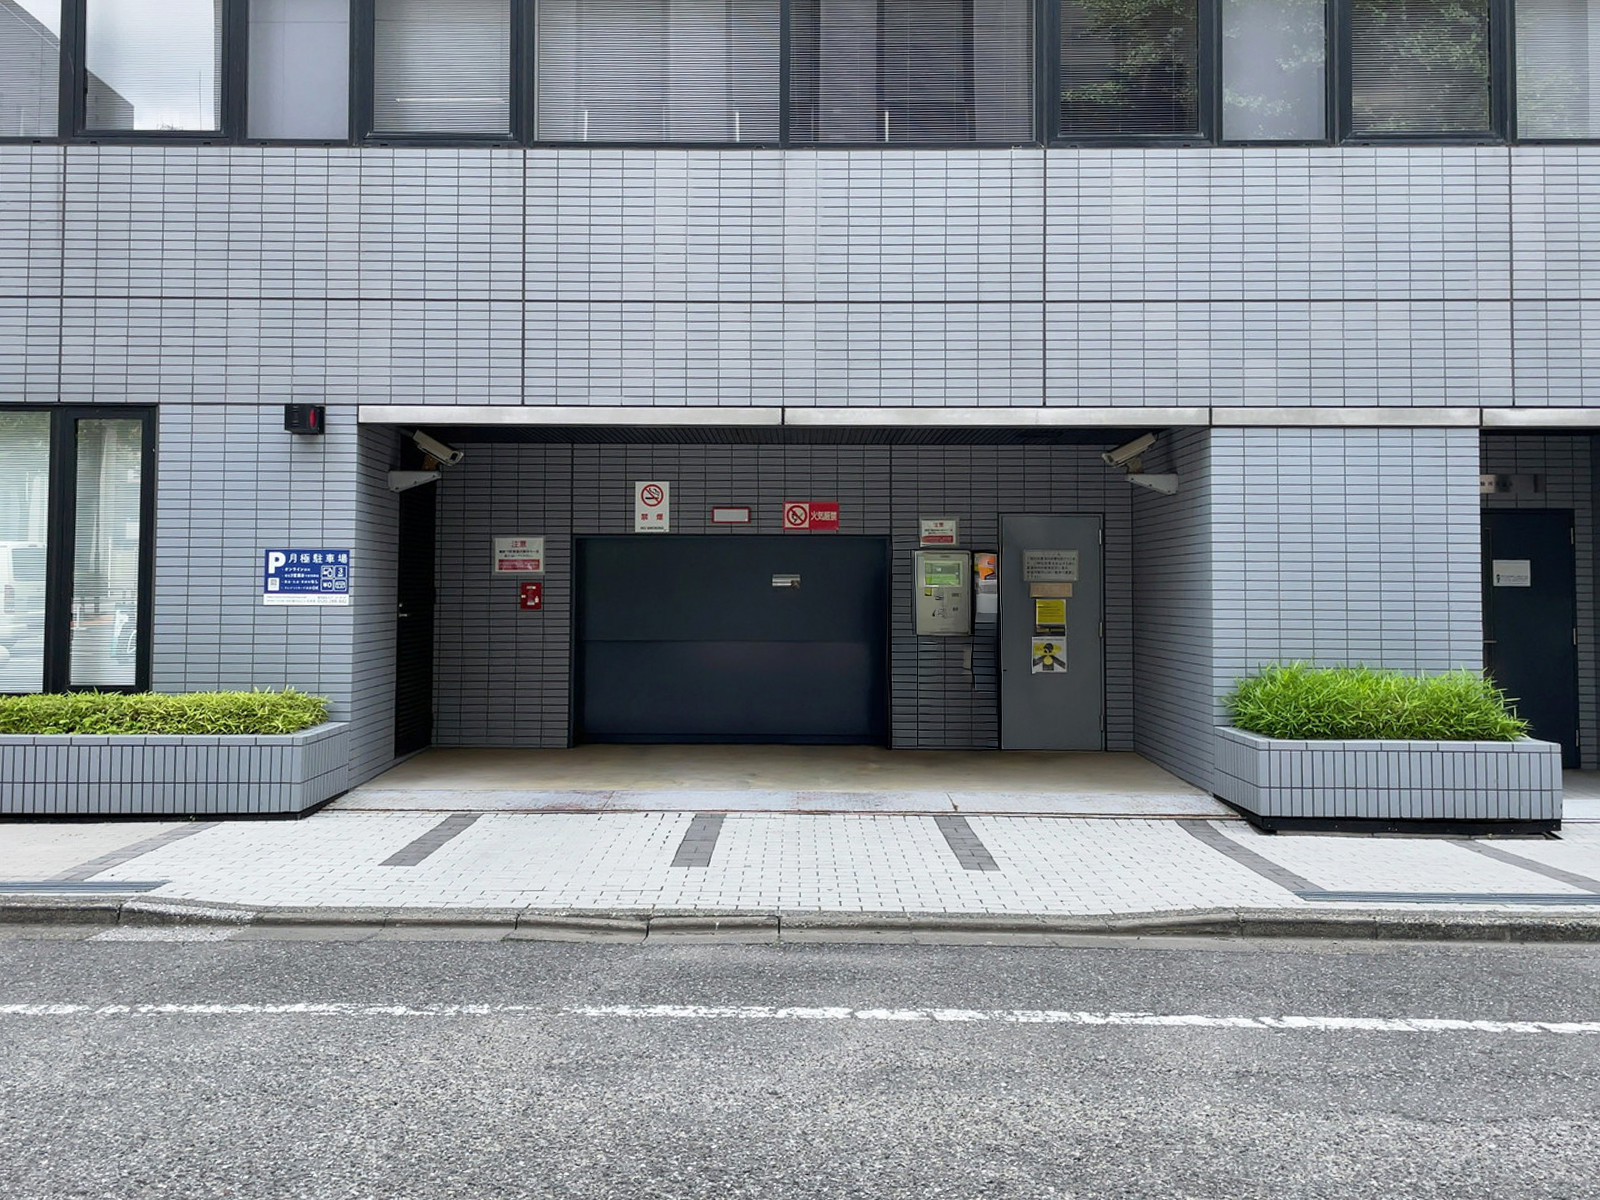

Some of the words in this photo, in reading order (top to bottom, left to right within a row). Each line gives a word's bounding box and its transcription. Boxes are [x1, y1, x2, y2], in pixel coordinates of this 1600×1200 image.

[268, 551, 286, 574] P
[288, 553, 348, 564] 月極駐車場
